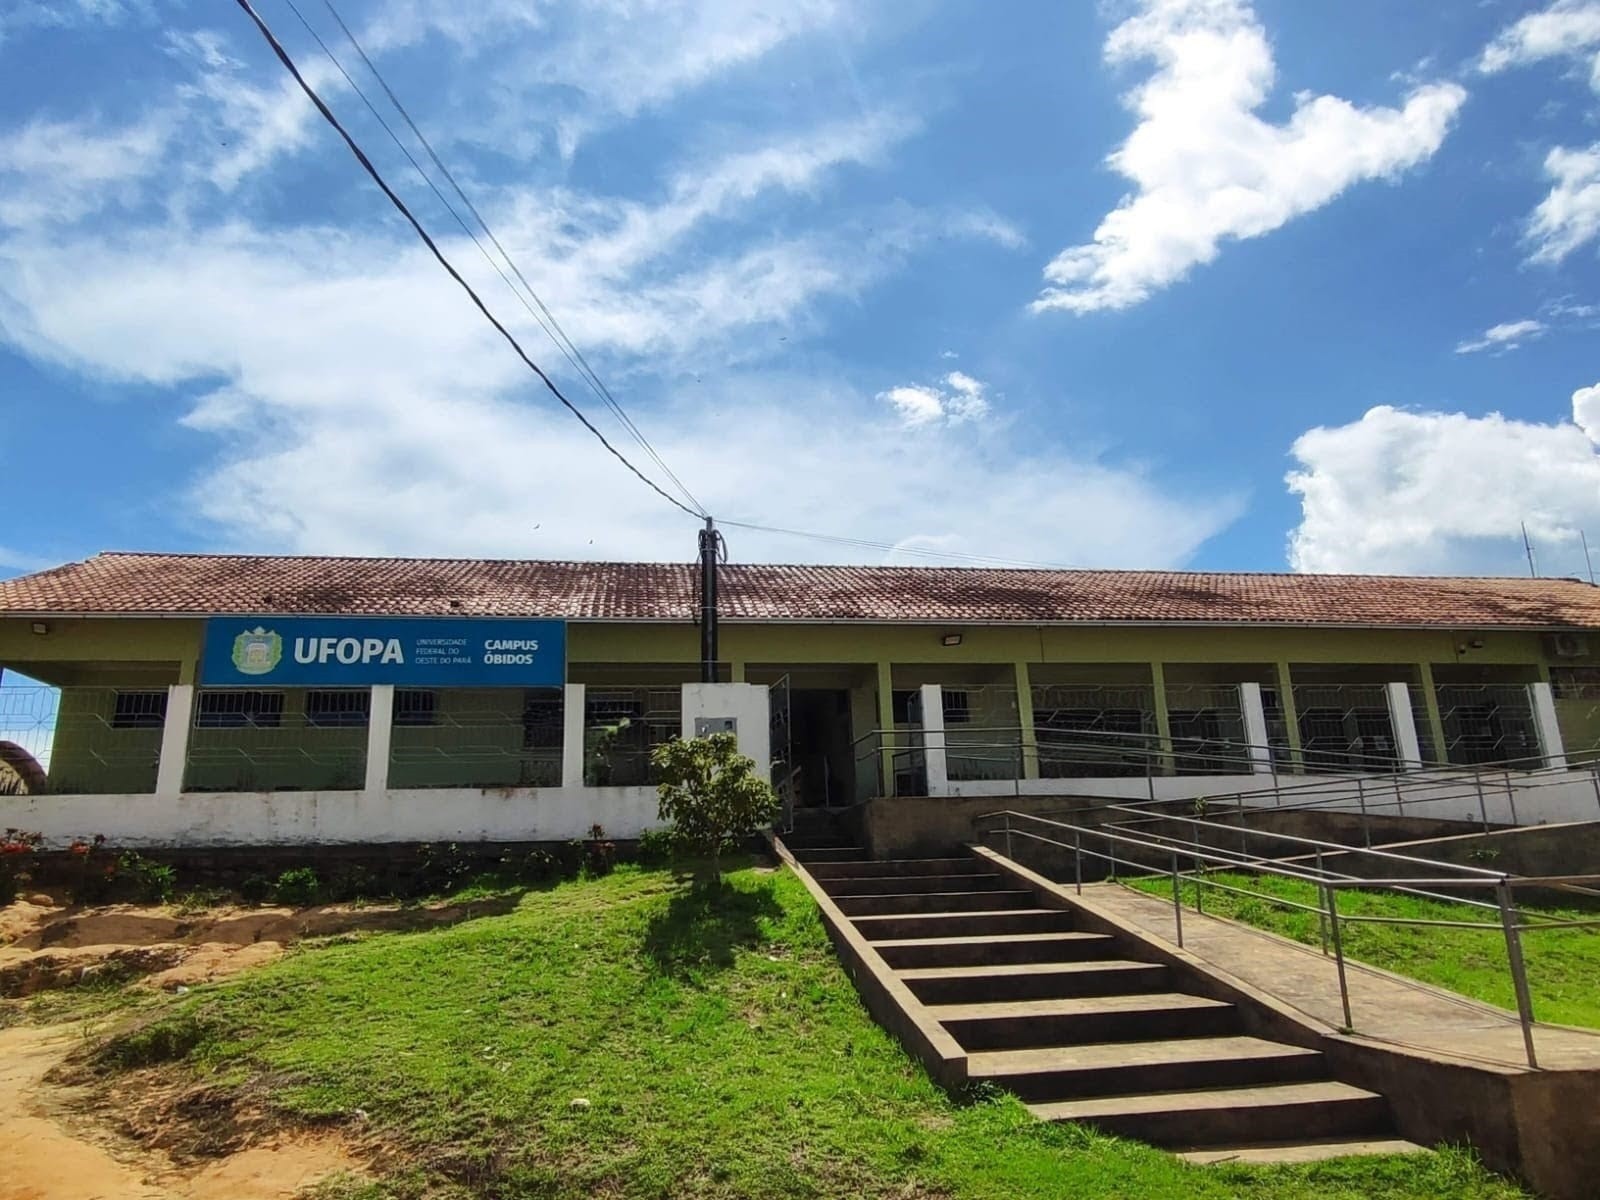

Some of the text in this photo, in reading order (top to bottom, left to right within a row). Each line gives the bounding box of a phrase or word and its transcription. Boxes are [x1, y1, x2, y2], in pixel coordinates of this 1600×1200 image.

[416, 638, 468, 646] UNIVERSIDADE
[484, 639, 539, 650] CAMPUS
[294, 637, 404, 665] UFOPA
[416, 647, 460, 655] FEDERAL DO
[415, 656, 438, 665] OESTE
[440, 656, 451, 665] DO
[484, 651, 534, 665] ÓBIDOS
